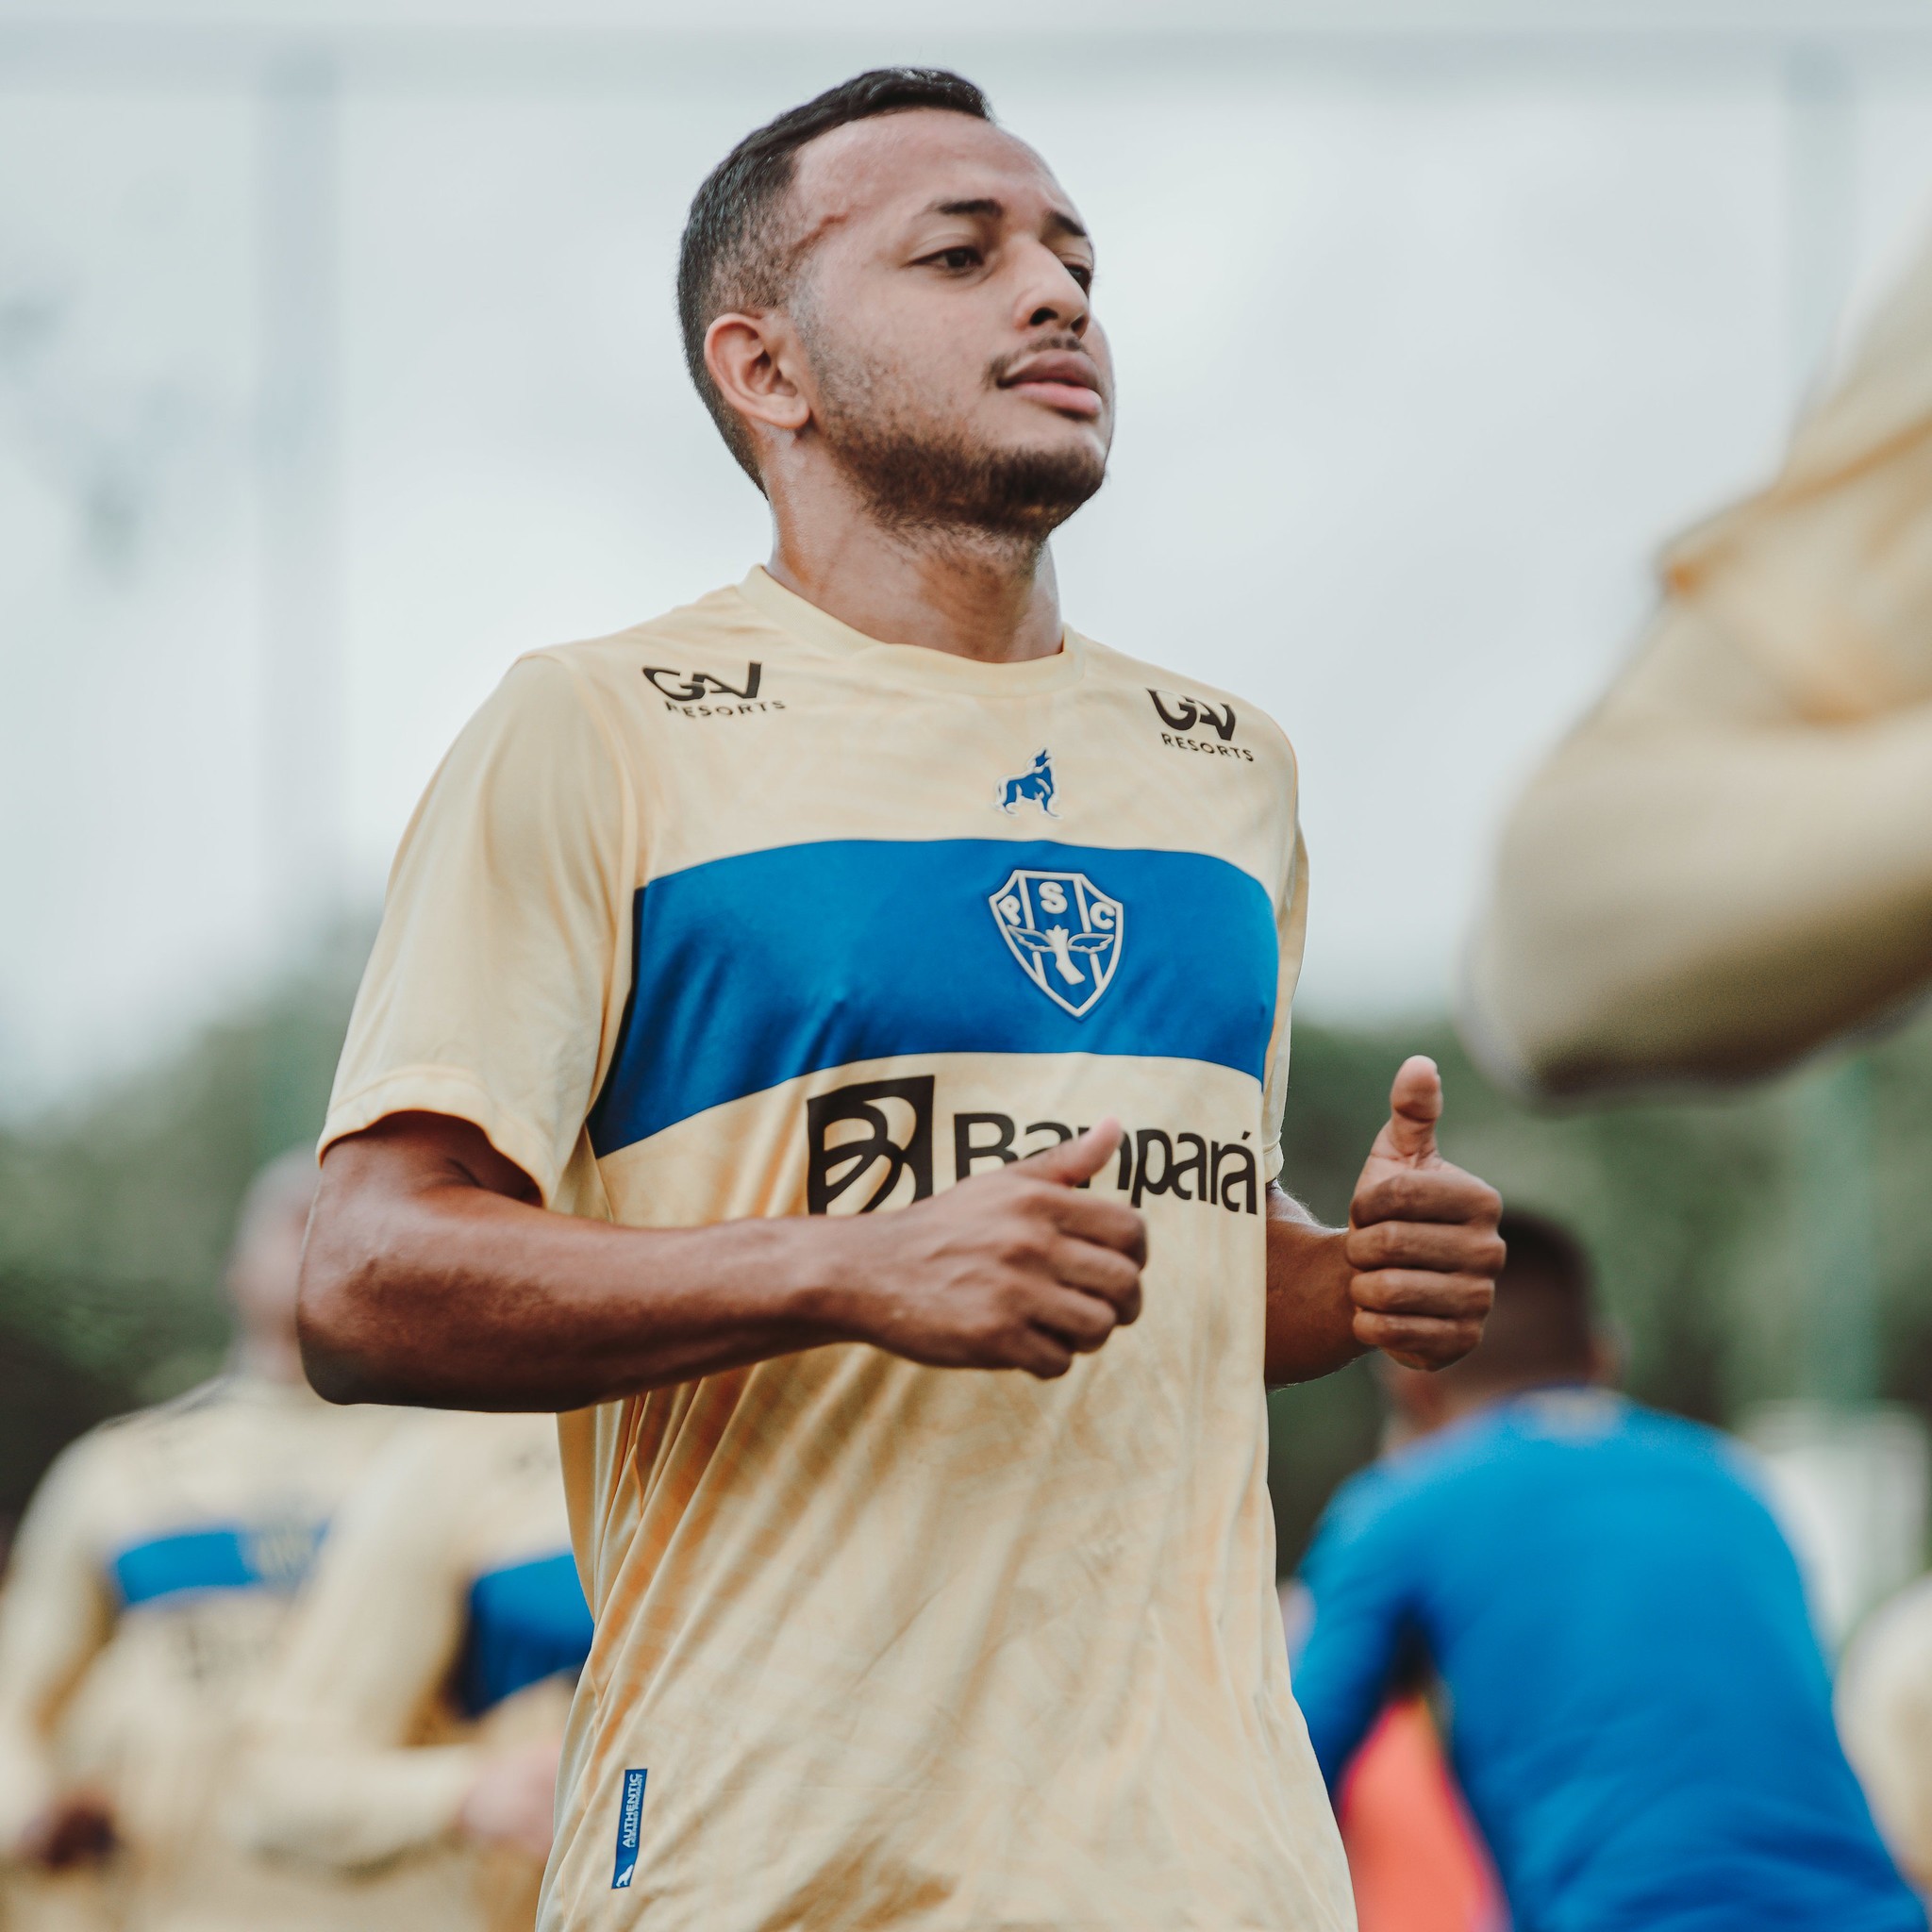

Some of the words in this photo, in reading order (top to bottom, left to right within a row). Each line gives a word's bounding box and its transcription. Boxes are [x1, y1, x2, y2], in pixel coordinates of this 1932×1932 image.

[664, 700, 786, 718] RESORTS
[1161, 732, 1254, 762] RESORTS
[623, 1774, 640, 1848] AUTHENTIC
